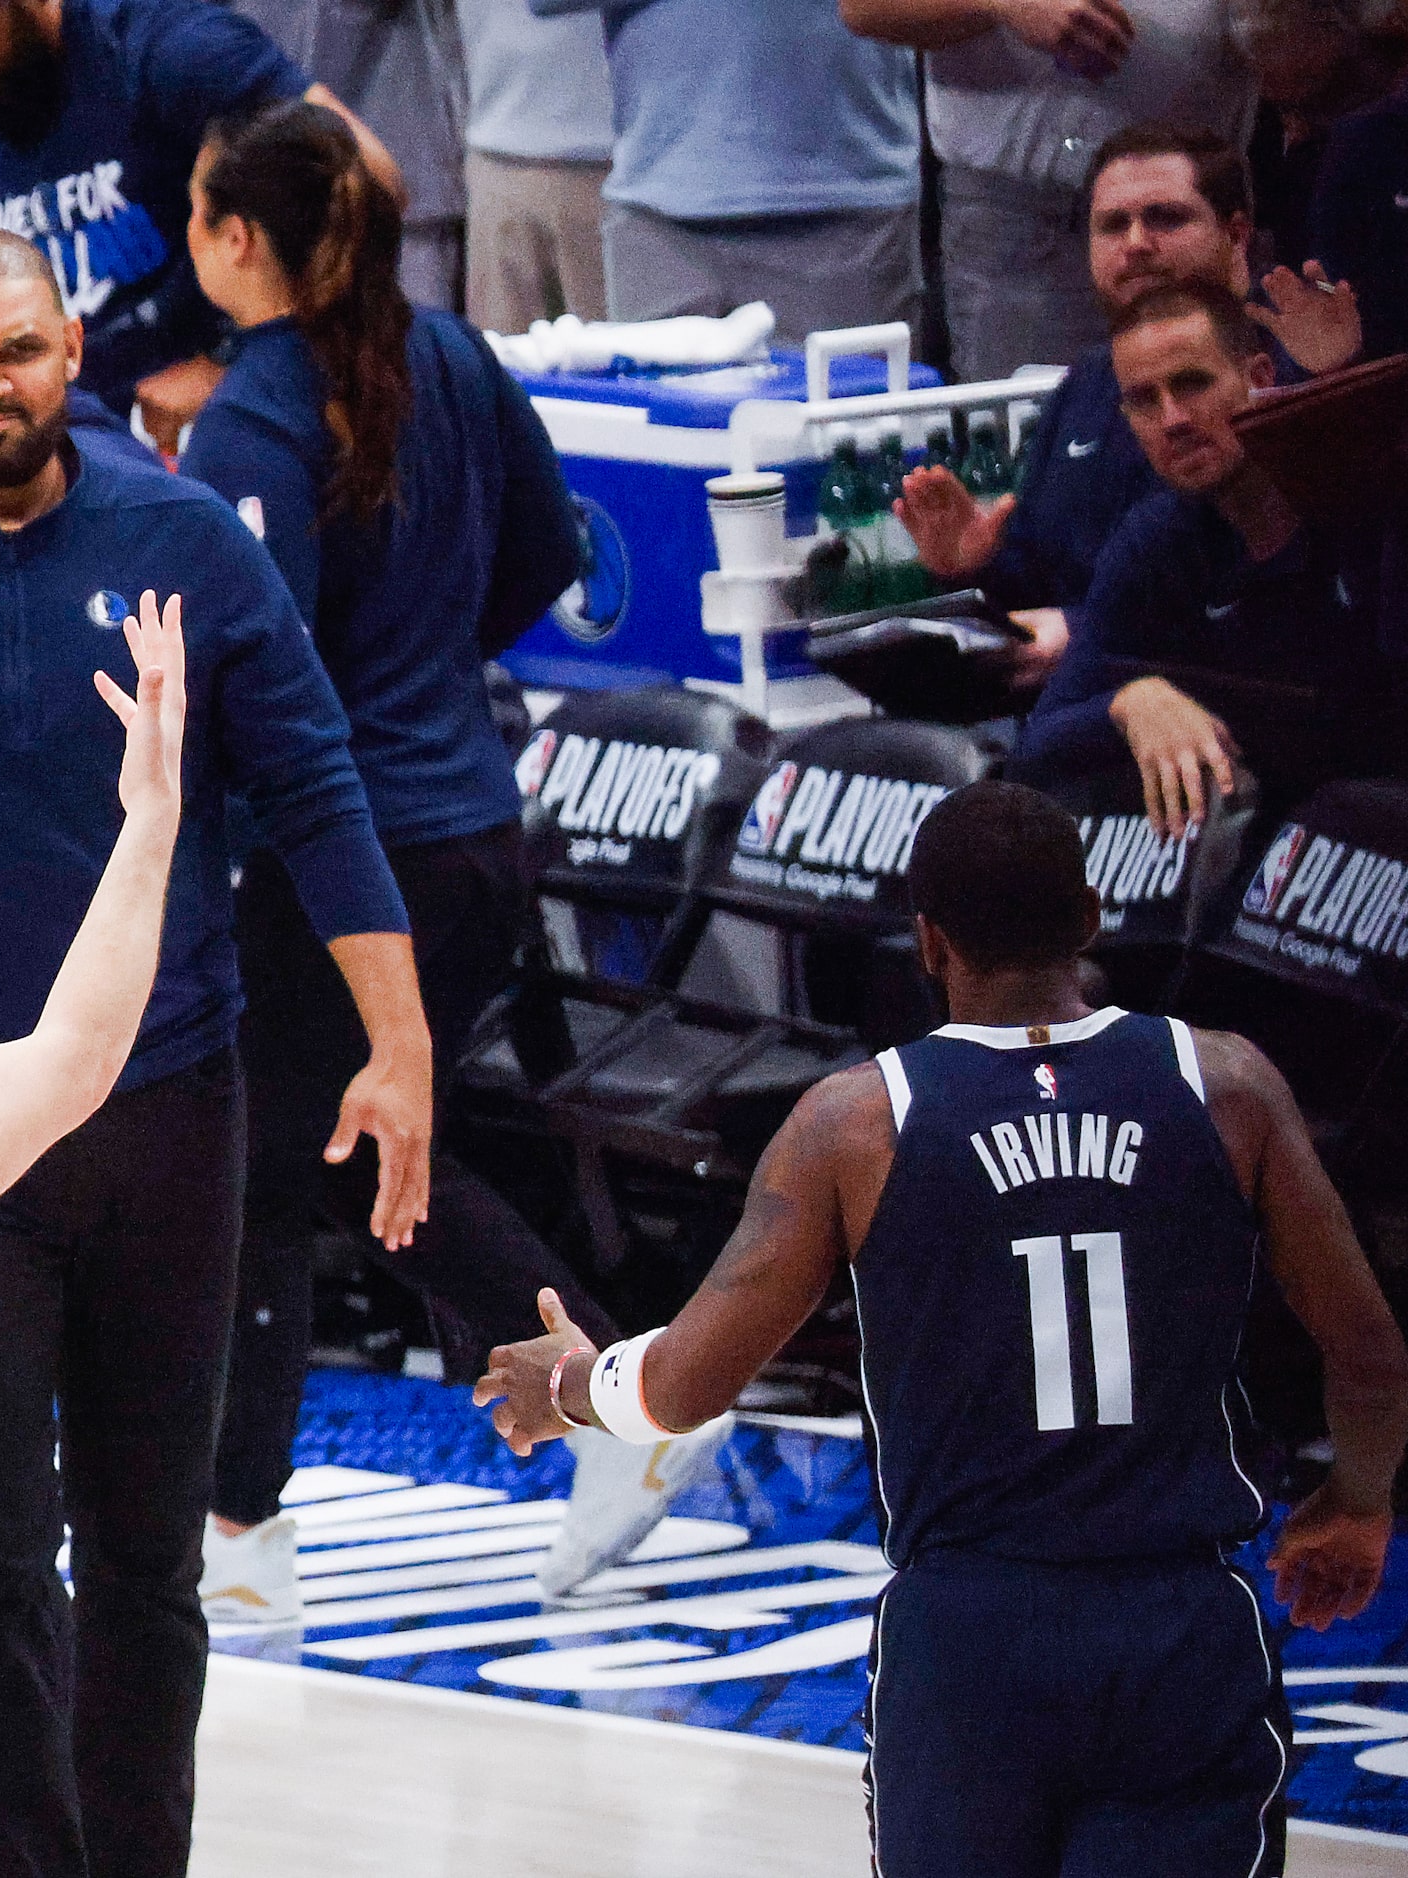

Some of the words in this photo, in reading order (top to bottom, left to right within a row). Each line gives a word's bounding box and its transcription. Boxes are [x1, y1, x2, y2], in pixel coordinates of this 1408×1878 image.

[57, 160, 128, 232] FOR
[48, 230, 115, 321] LL
[540, 733, 721, 840] PLAYOFFS
[774, 765, 949, 876] PLAYOFF
[1078, 814, 1199, 902] AYOFFS
[970, 1113, 1144, 1194] IRVING
[1011, 1232, 1133, 1431] 11
